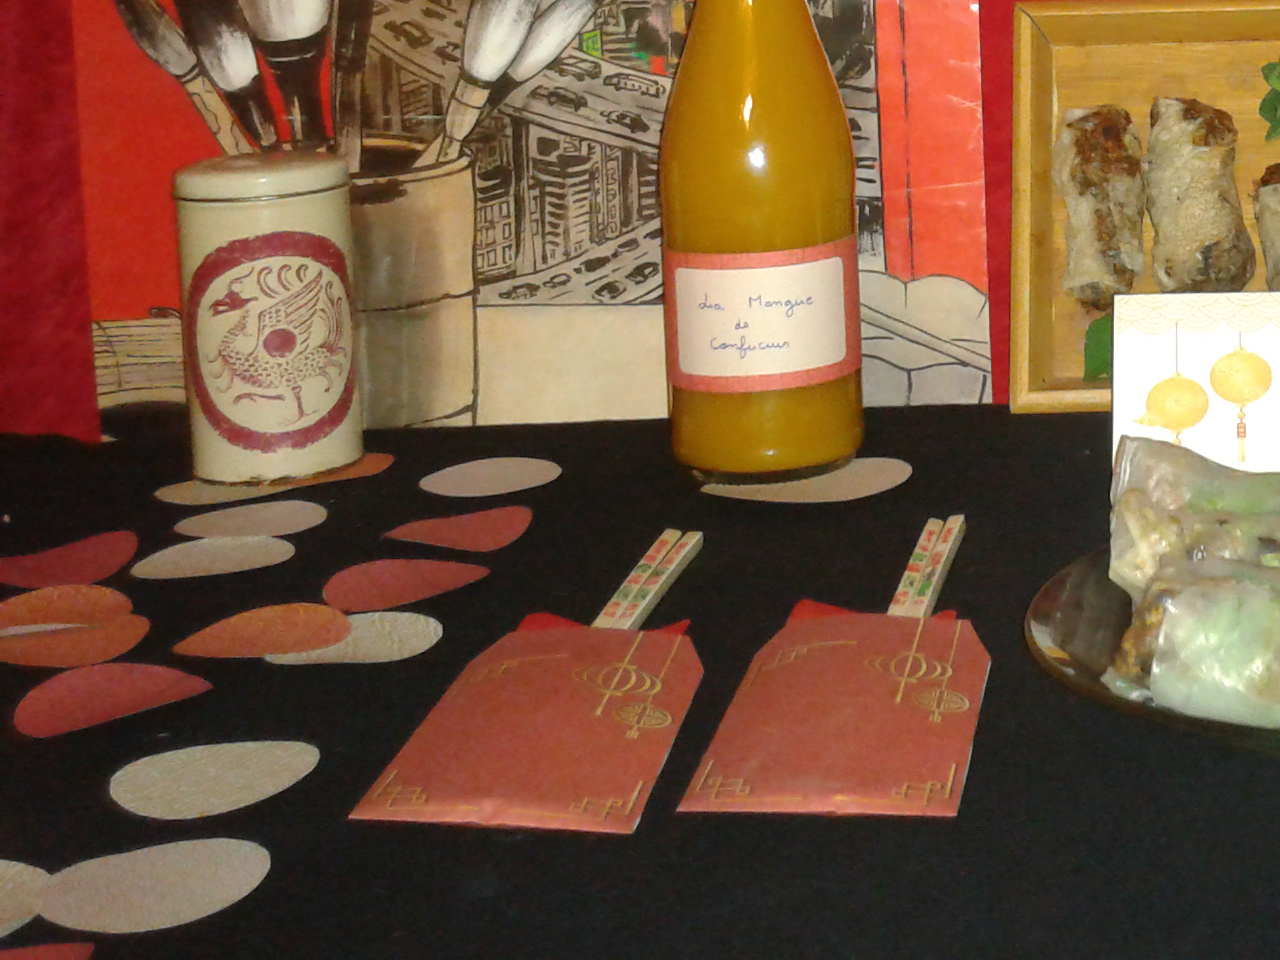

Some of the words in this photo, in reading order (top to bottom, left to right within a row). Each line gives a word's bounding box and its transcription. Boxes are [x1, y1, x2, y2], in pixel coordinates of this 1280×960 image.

[748, 294, 815, 318] Mangue
[734, 318, 750, 331] de
[709, 335, 790, 360] Confucius
